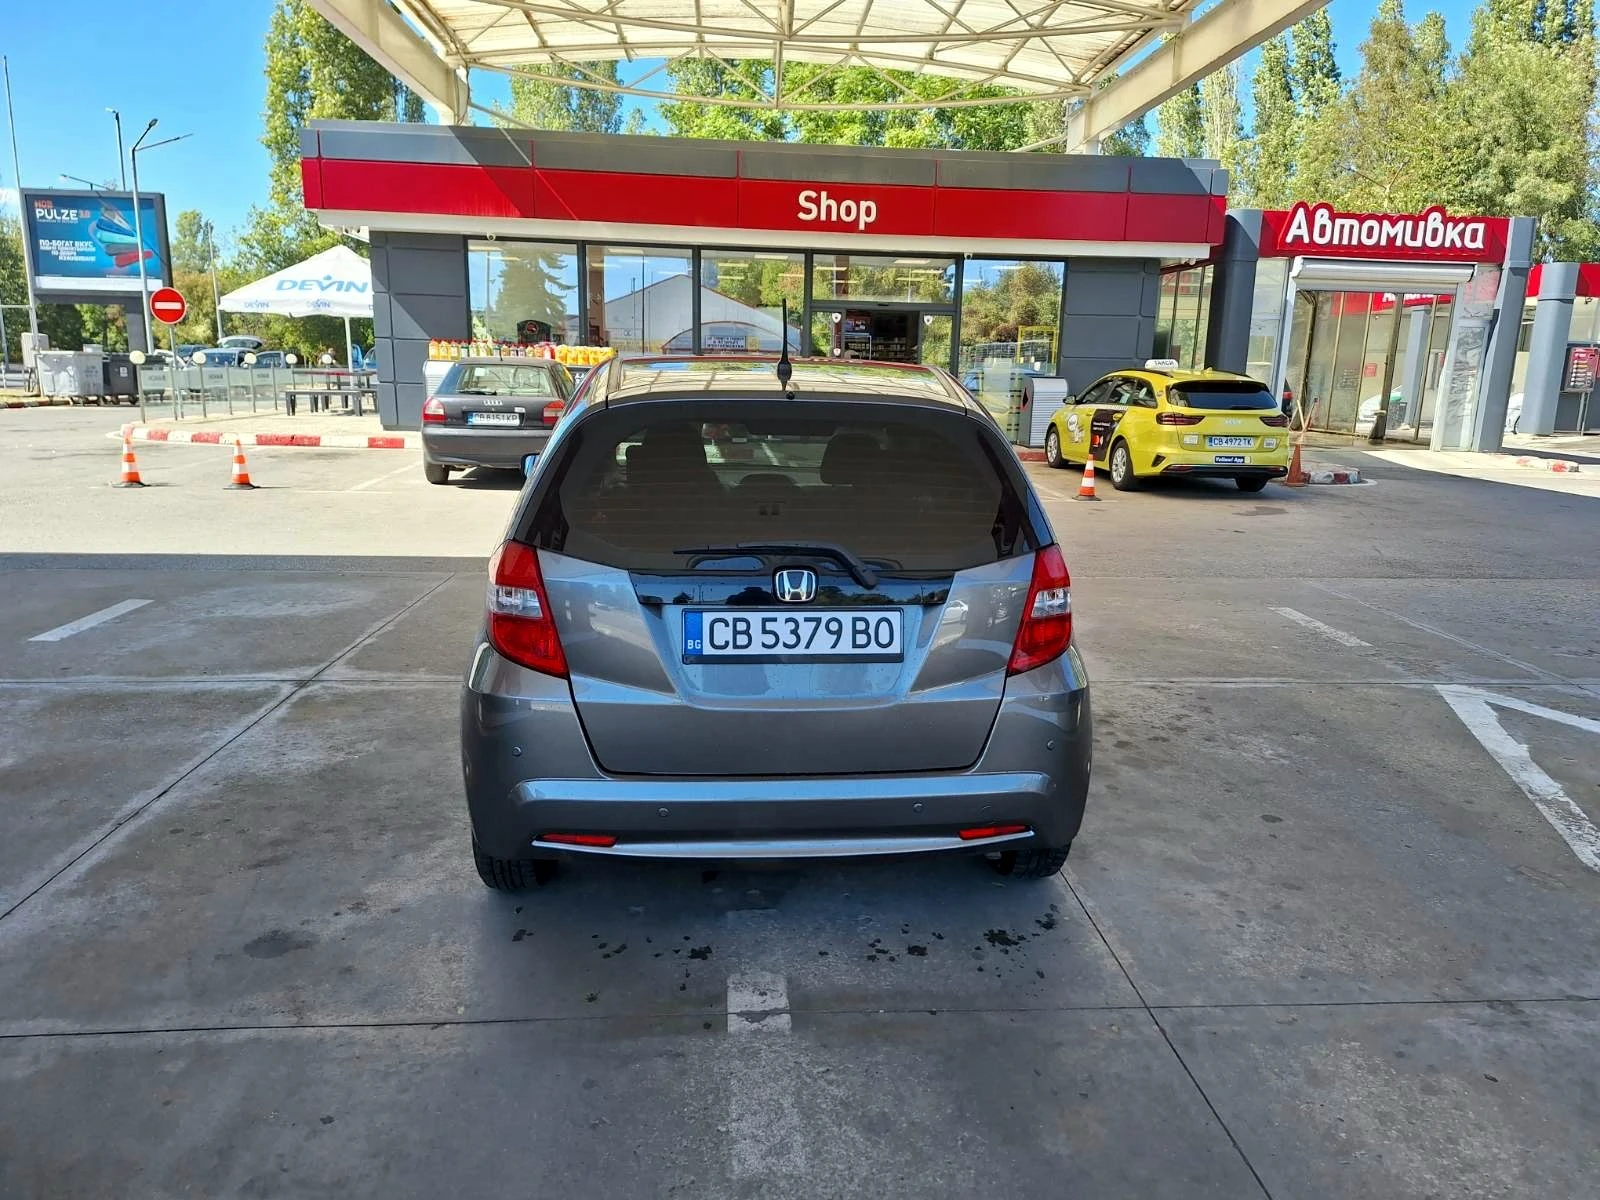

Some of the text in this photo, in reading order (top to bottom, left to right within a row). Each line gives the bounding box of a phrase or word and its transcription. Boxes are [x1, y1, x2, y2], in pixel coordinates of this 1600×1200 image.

[35, 208, 79, 220] PULZE
[797, 190, 877, 231] Shop
[1285, 207, 1485, 249] Автомивка
[276, 276, 369, 293] DEVIN
[1224, 437, 1242, 446] 4972
[687, 616, 894, 650] BG CB 5379 BO
